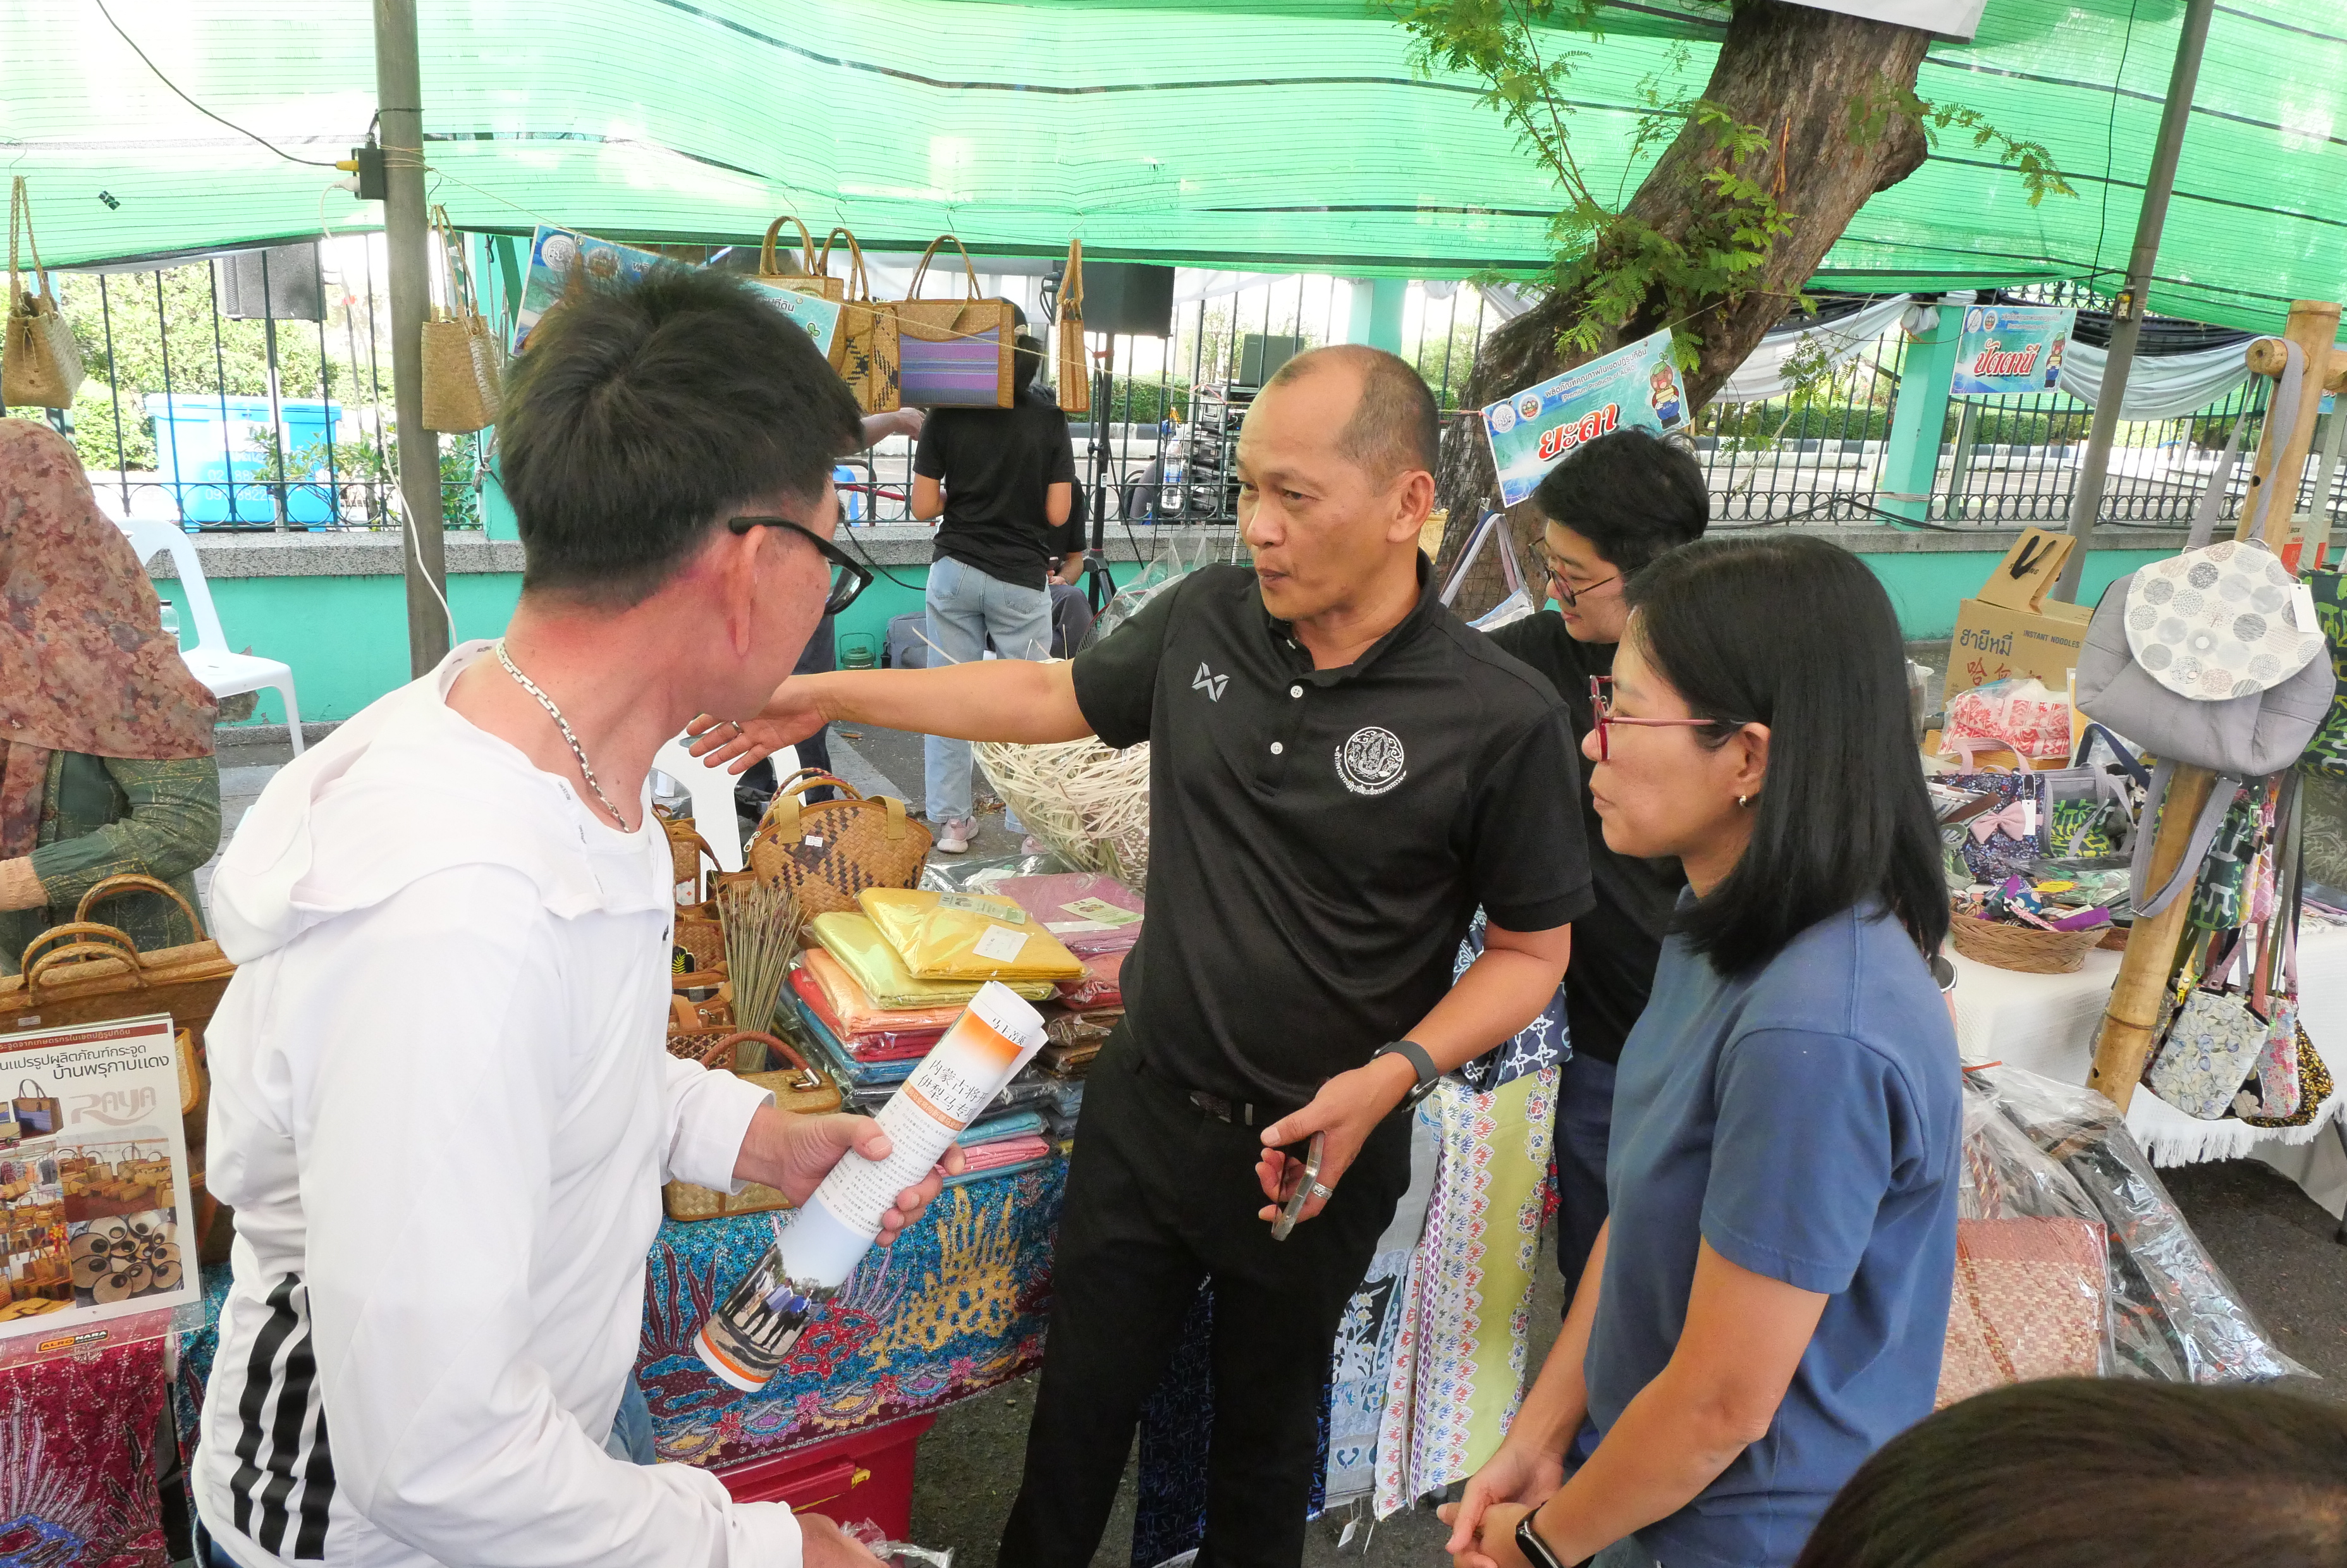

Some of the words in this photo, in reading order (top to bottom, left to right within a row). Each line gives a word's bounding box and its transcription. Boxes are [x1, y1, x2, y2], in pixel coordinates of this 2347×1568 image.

[1974, 338, 2041, 377] ปัตตานี
[1545, 348, 1646, 398] ผลิตภัณฑ์คุณภาพในเขตปฏิรูปที่ดิน
[1562, 388, 1588, 401] (Premium
[1588, 376, 1612, 389] Products
[1621, 364, 1637, 376] ALRO)
[1538, 403, 1620, 462] ยะลา
[207, 469, 224, 482] 02
[234, 470, 254, 482] 88
[1959, 628, 2014, 656] ฮายีหมี่
[2023, 630, 2049, 641] INSTANT
[2050, 636, 2080, 648] NOODLES
[53, 1055, 169, 1080] บ้านพรุกาบแดง
[42, 1339, 73, 1349] ALRO
[75, 1331, 107, 1340] NARA
